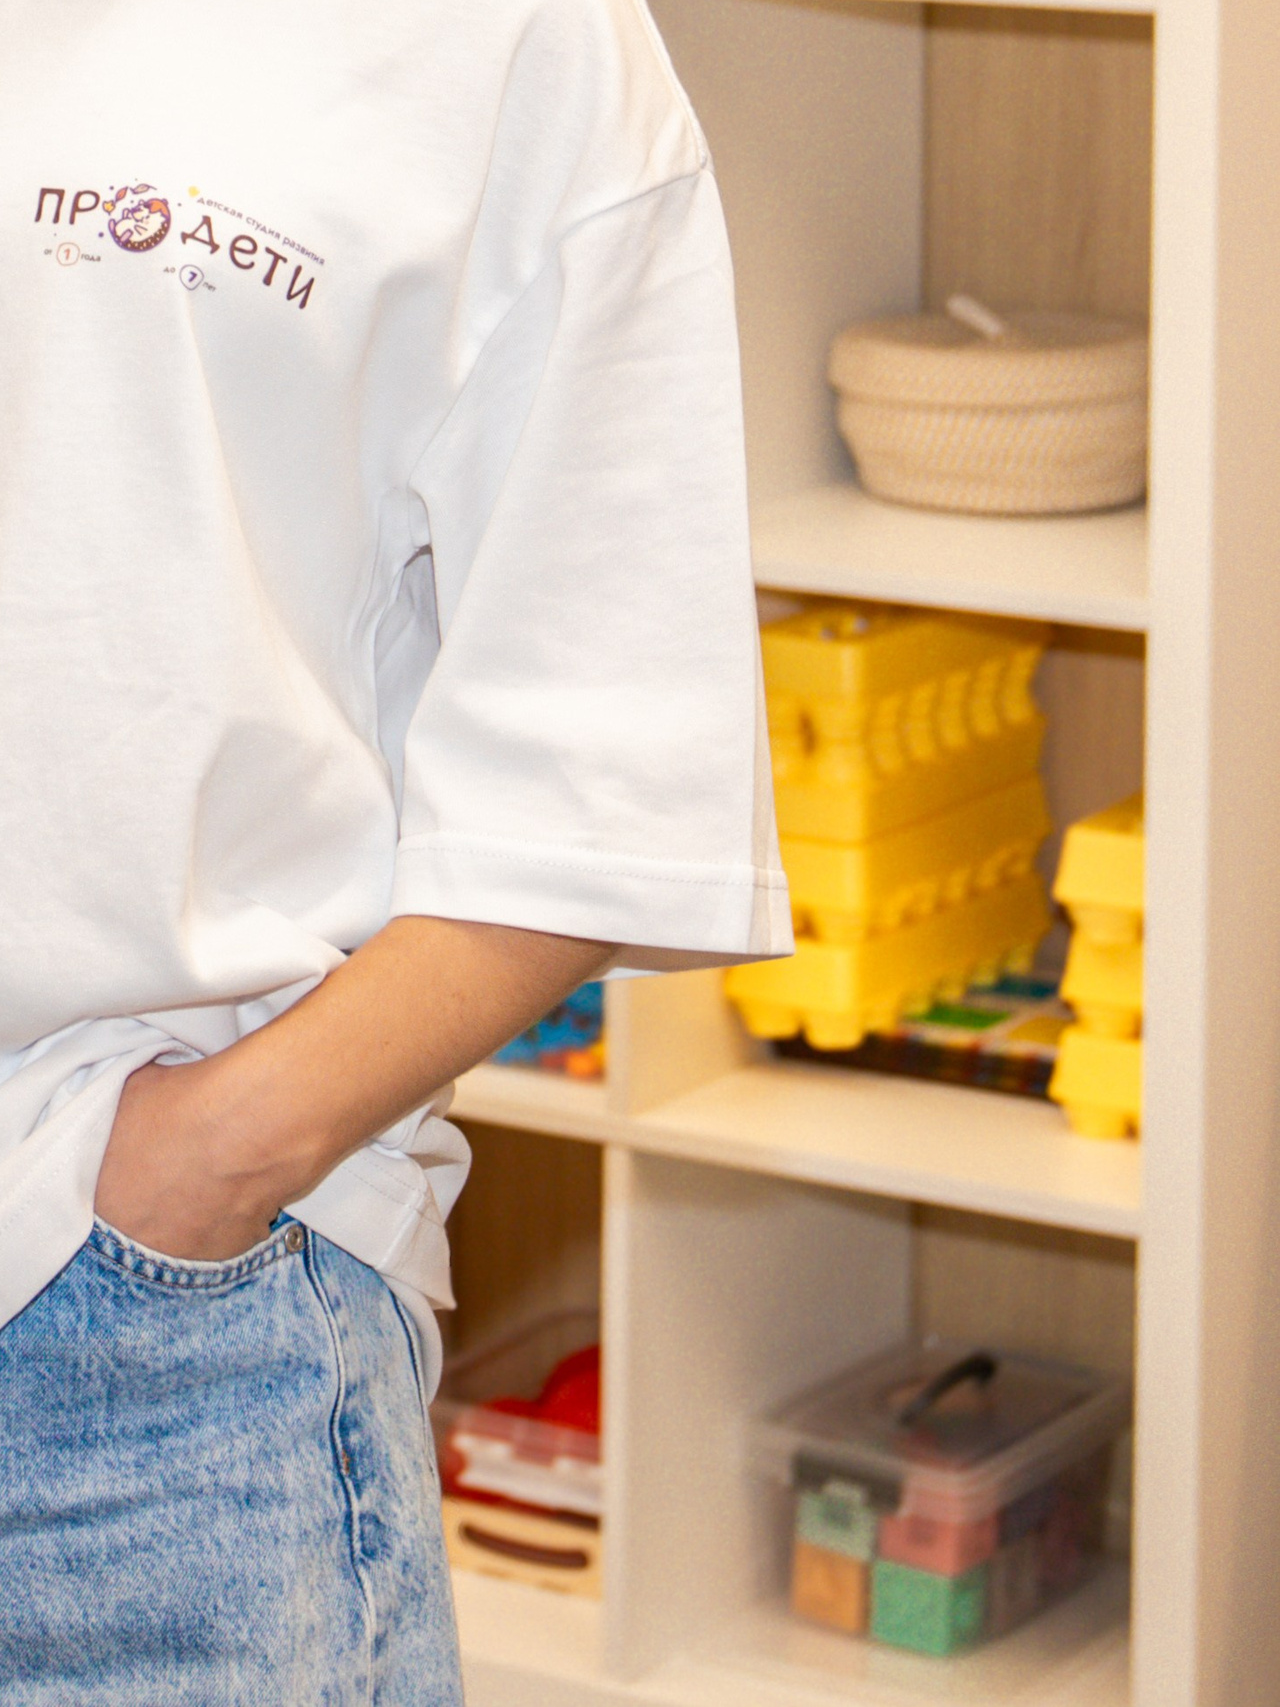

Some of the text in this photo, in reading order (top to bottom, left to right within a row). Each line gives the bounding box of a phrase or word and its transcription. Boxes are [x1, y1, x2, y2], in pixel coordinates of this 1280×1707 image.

[197, 197, 326, 267] детская студия развития
[81, 252, 102, 263] года
